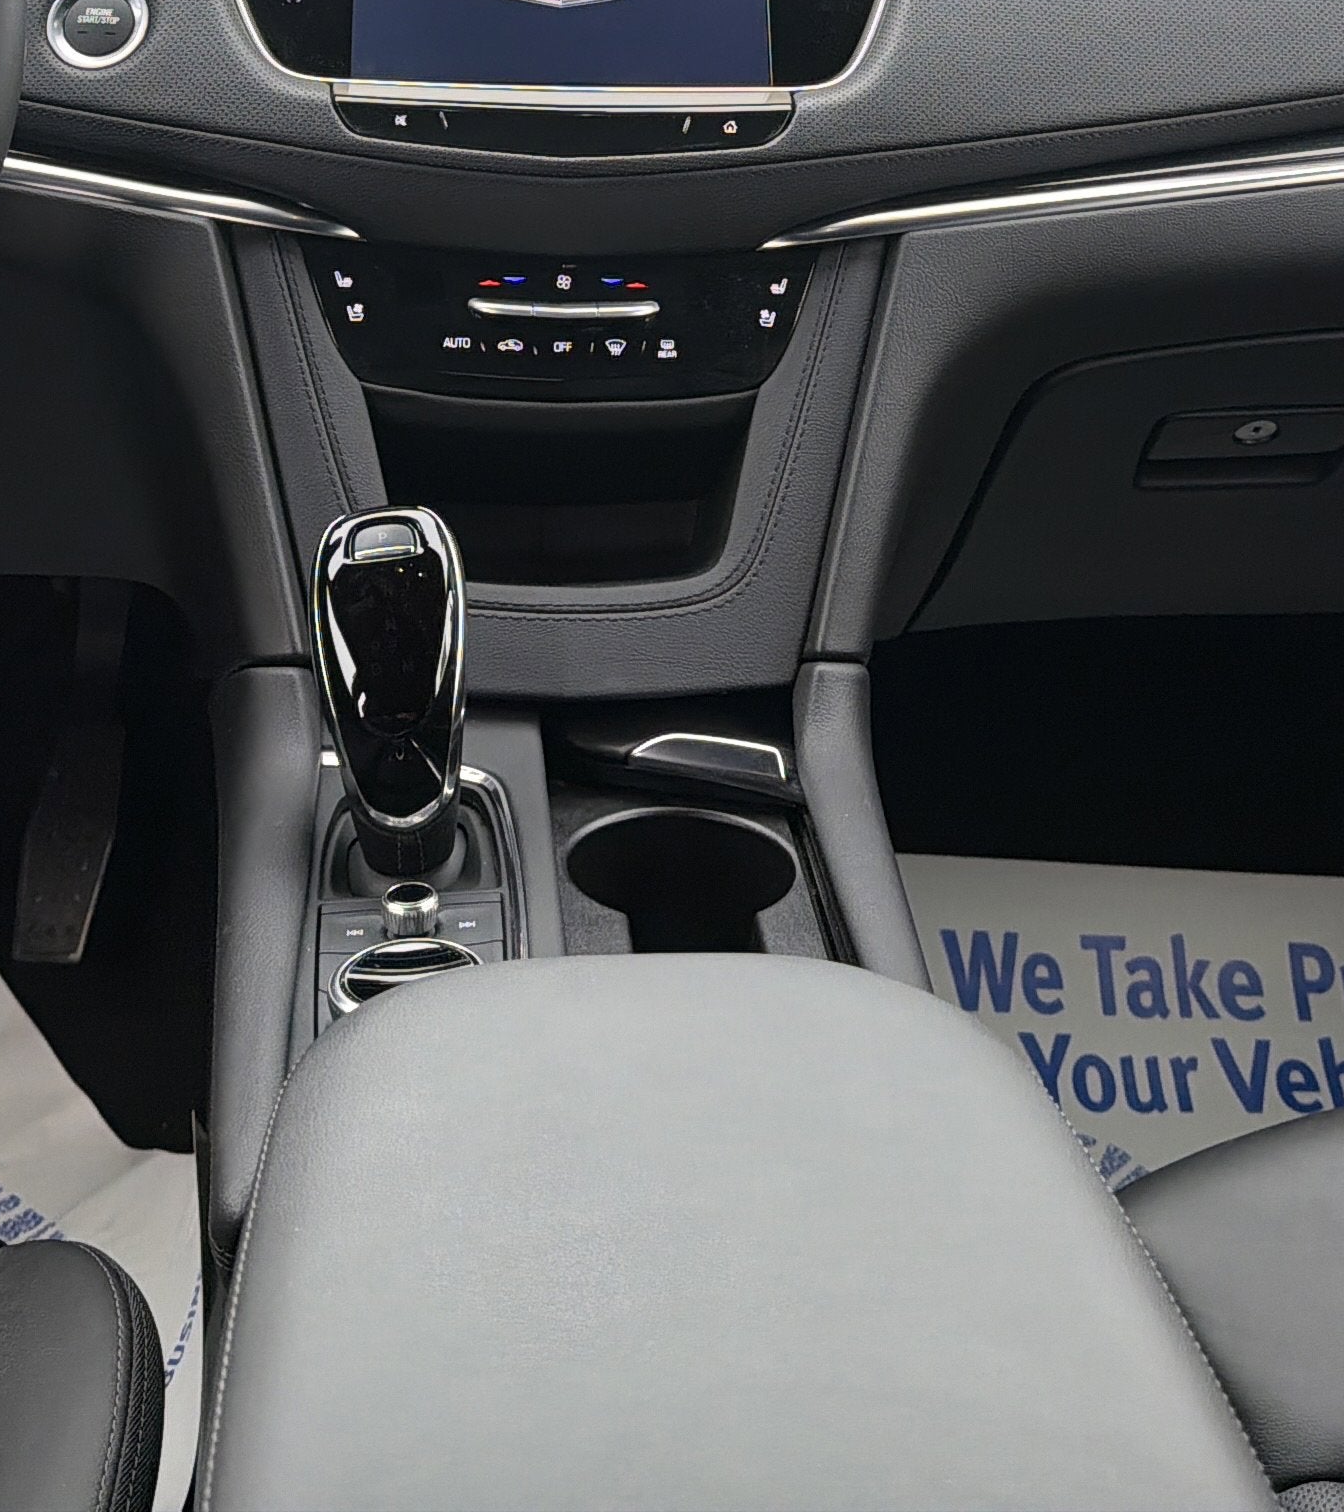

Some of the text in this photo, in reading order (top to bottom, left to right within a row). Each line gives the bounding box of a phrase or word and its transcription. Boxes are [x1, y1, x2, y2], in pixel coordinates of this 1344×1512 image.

[85, 7, 115, 16] ENGINE
[77, 15, 120, 25] START/STOP
[443, 337, 471, 349] AUTO
[553, 341, 573, 353] OFF
[657, 350, 678, 359] REAR
[377, 532, 387, 543] P
[940, 928, 1064, 1016] We
[1079, 933, 1265, 1021] Take
[1017, 1031, 1199, 1115] Your
